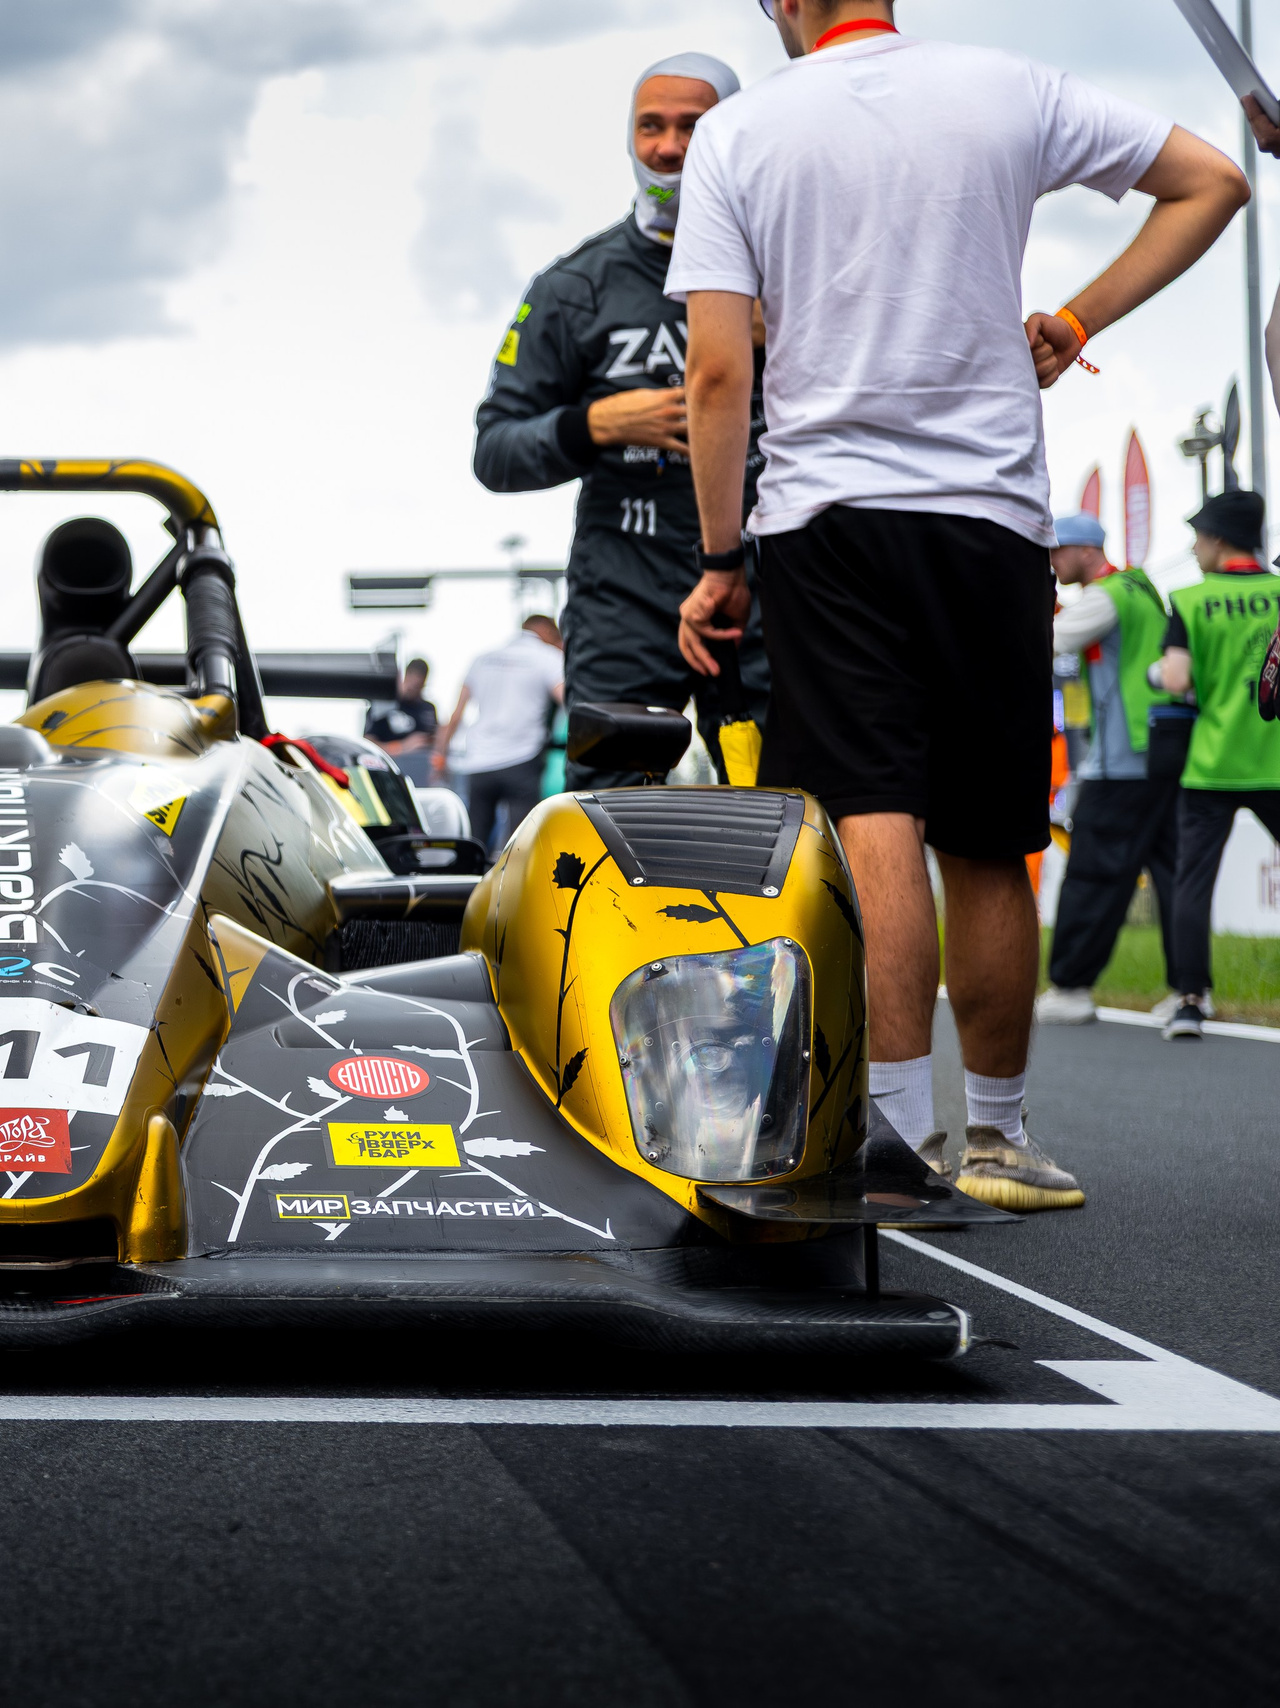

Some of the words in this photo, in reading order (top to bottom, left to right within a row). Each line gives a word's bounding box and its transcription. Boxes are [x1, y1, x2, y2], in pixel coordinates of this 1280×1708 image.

[621, 498, 656, 536] 111
[337, 1060, 421, 1095] ЮНОСТЬ
[364, 1131, 421, 1140] РУКИ
[368, 1149, 410, 1158] БАР
[277, 1199, 343, 1214] МИР
[351, 1199, 535, 1217] ЗАПЧАСТЕЙ
